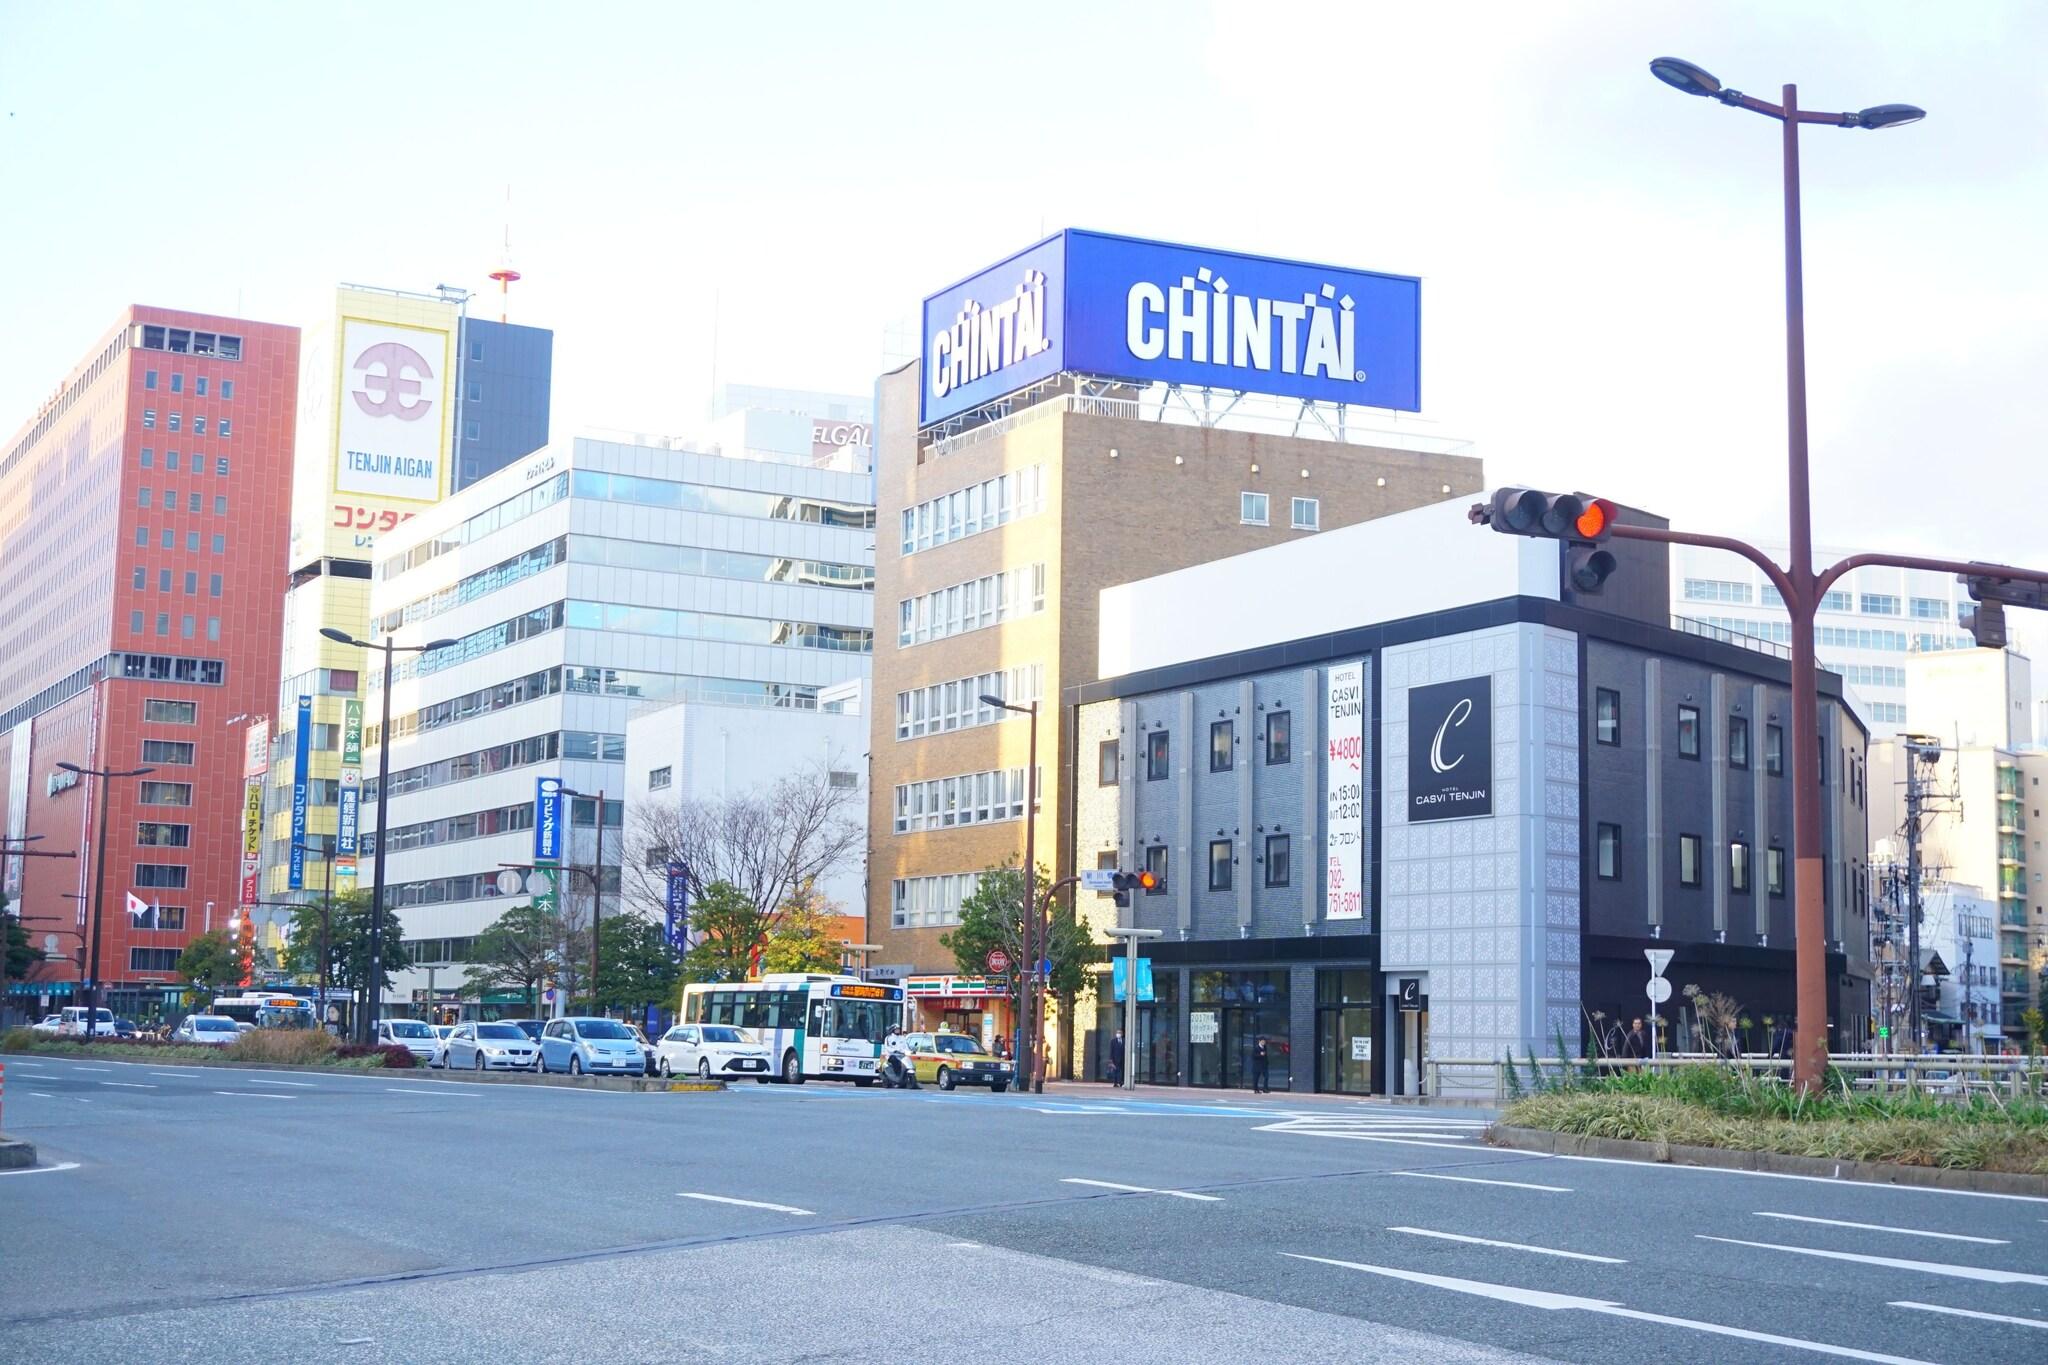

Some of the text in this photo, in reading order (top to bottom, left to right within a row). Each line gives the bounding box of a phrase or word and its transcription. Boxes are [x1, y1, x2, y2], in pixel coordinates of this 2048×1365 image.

[931, 269, 1046, 398] CHINTAI
[1125, 267, 1356, 382] CHINTAI
[346, 450, 433, 479] TENJIN AIGAN
[1334, 671, 1356, 682] HOTEL
[1331, 685, 1359, 703] CASVI
[1330, 702, 1361, 719] TENJIN
[1339, 784, 1361, 801] 15:00
[1415, 789, 1486, 805] CASVI TENJIN
[248, 793, 259, 851] ハローチケット
[341, 791, 356, 850] 産経新聞社
